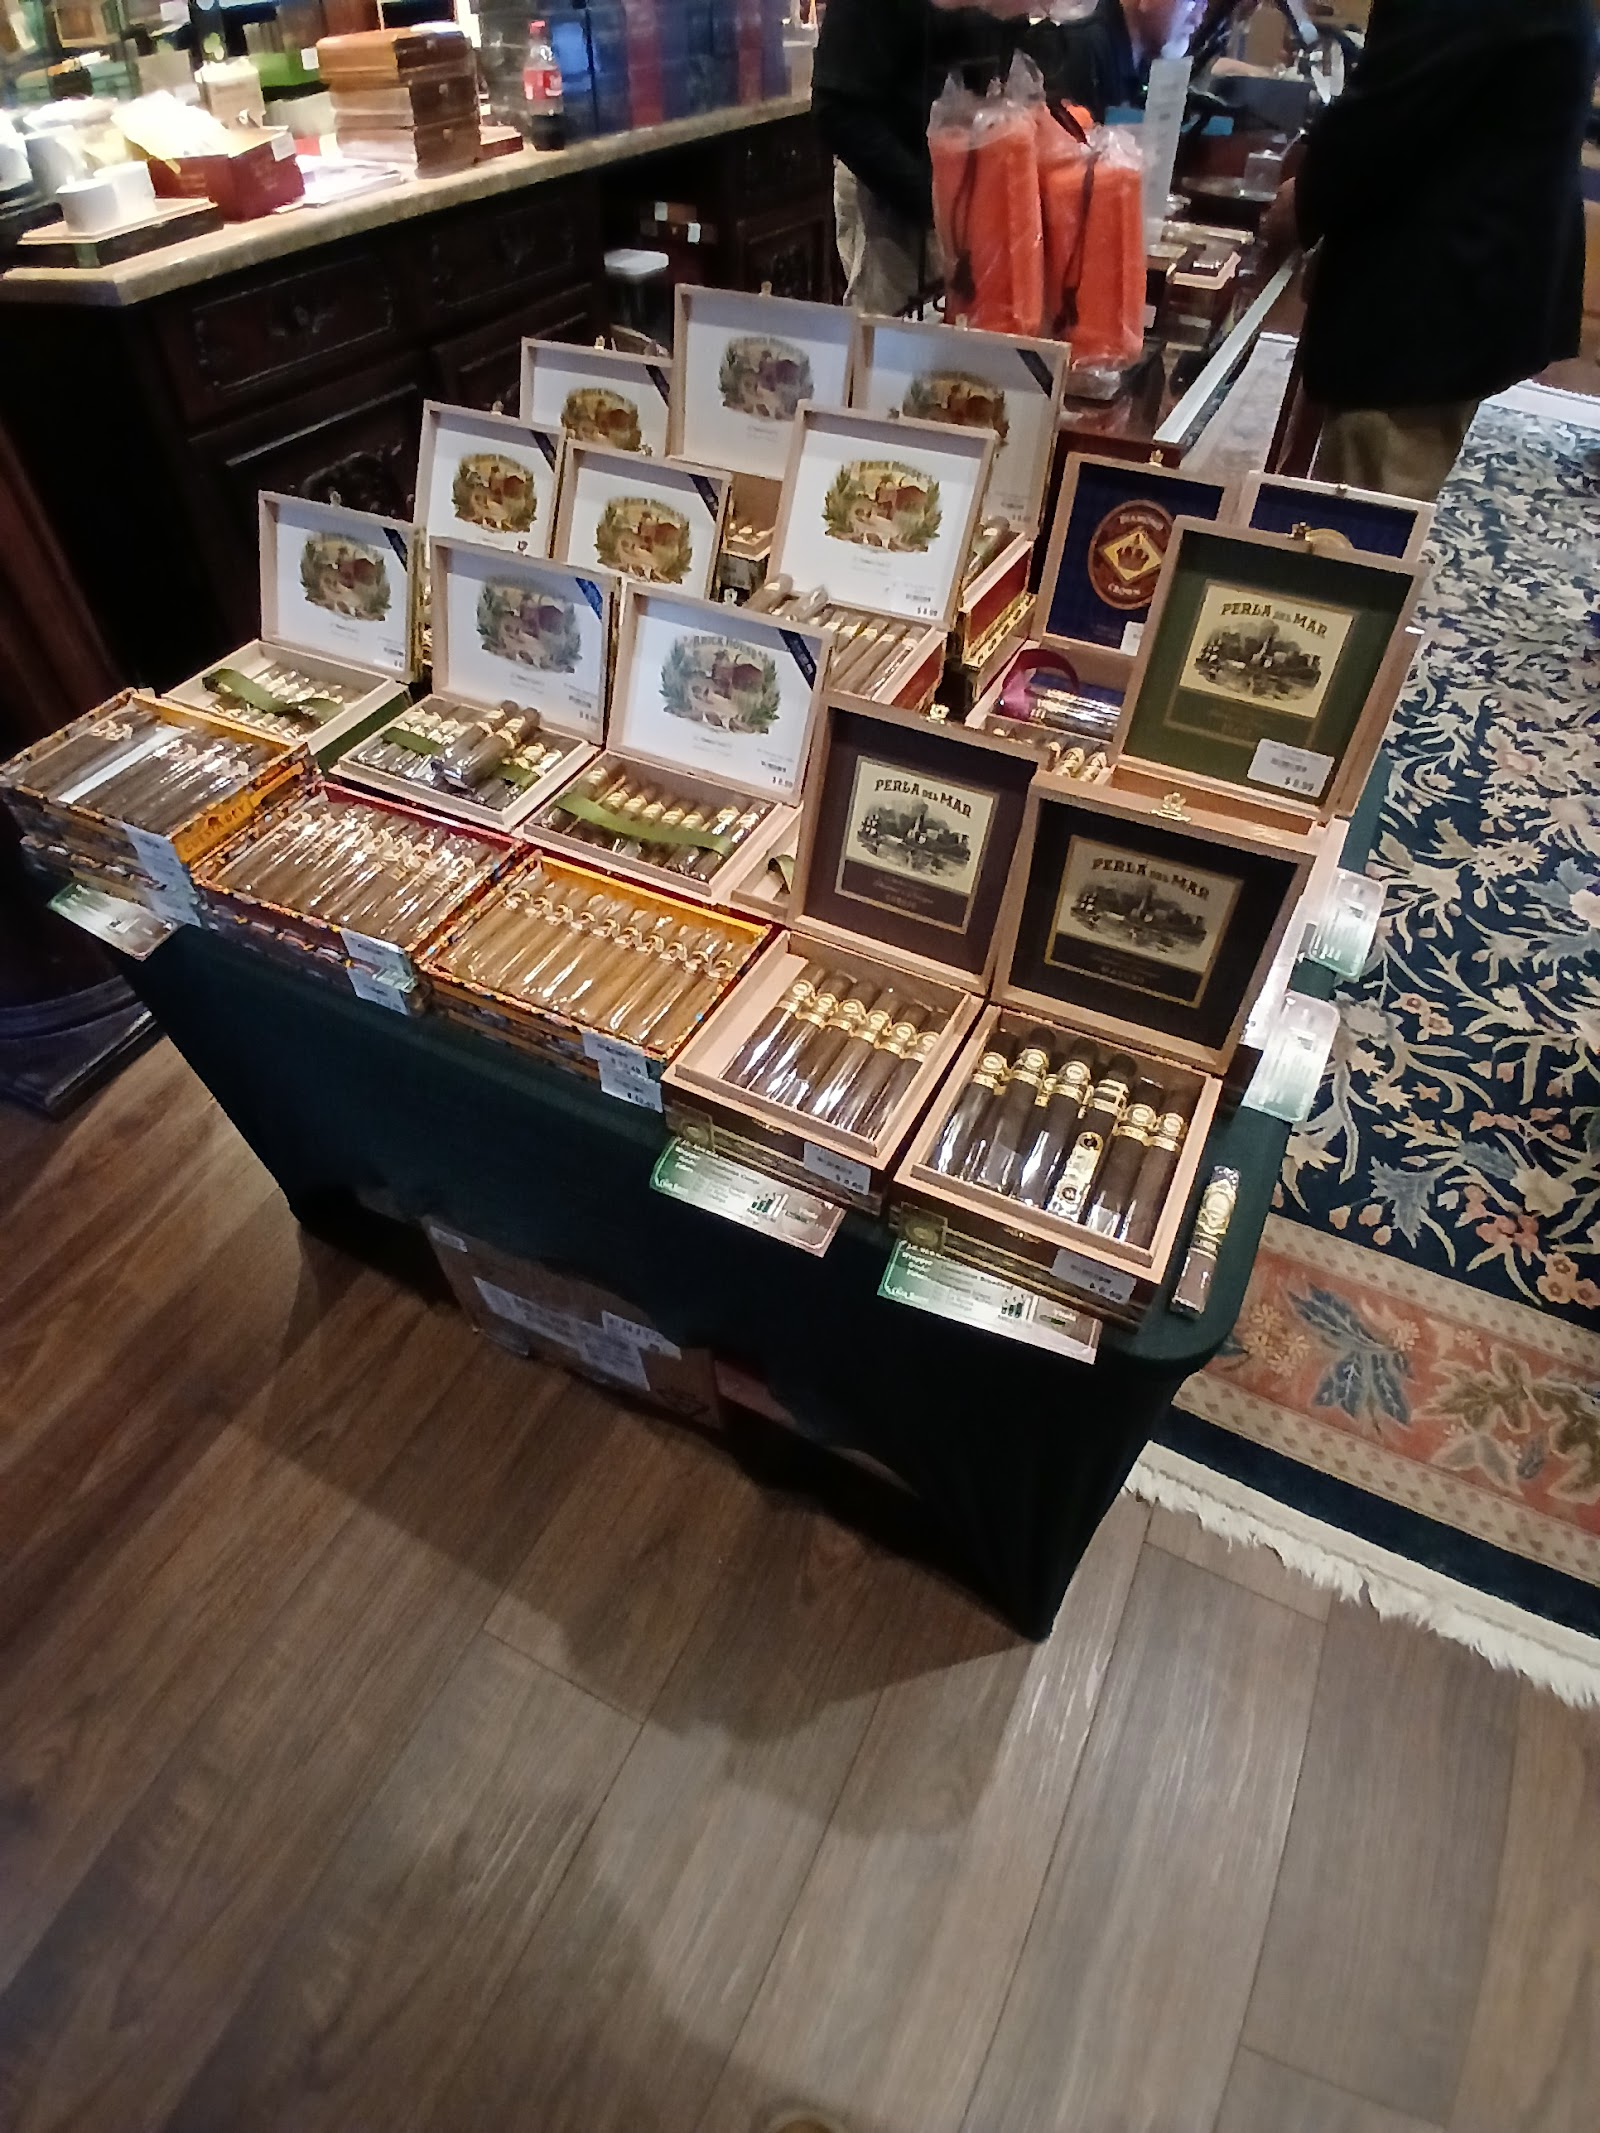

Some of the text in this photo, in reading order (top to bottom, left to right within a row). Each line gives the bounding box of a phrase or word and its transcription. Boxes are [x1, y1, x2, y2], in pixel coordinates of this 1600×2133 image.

[1221, 602, 1272, 617] PERLA
[1292, 613, 1328, 639] MAR
[874, 778, 972, 819] PERLA DEL MAR
[1092, 857, 1148, 876] PERLA
[1170, 873, 1211, 900] MAR
